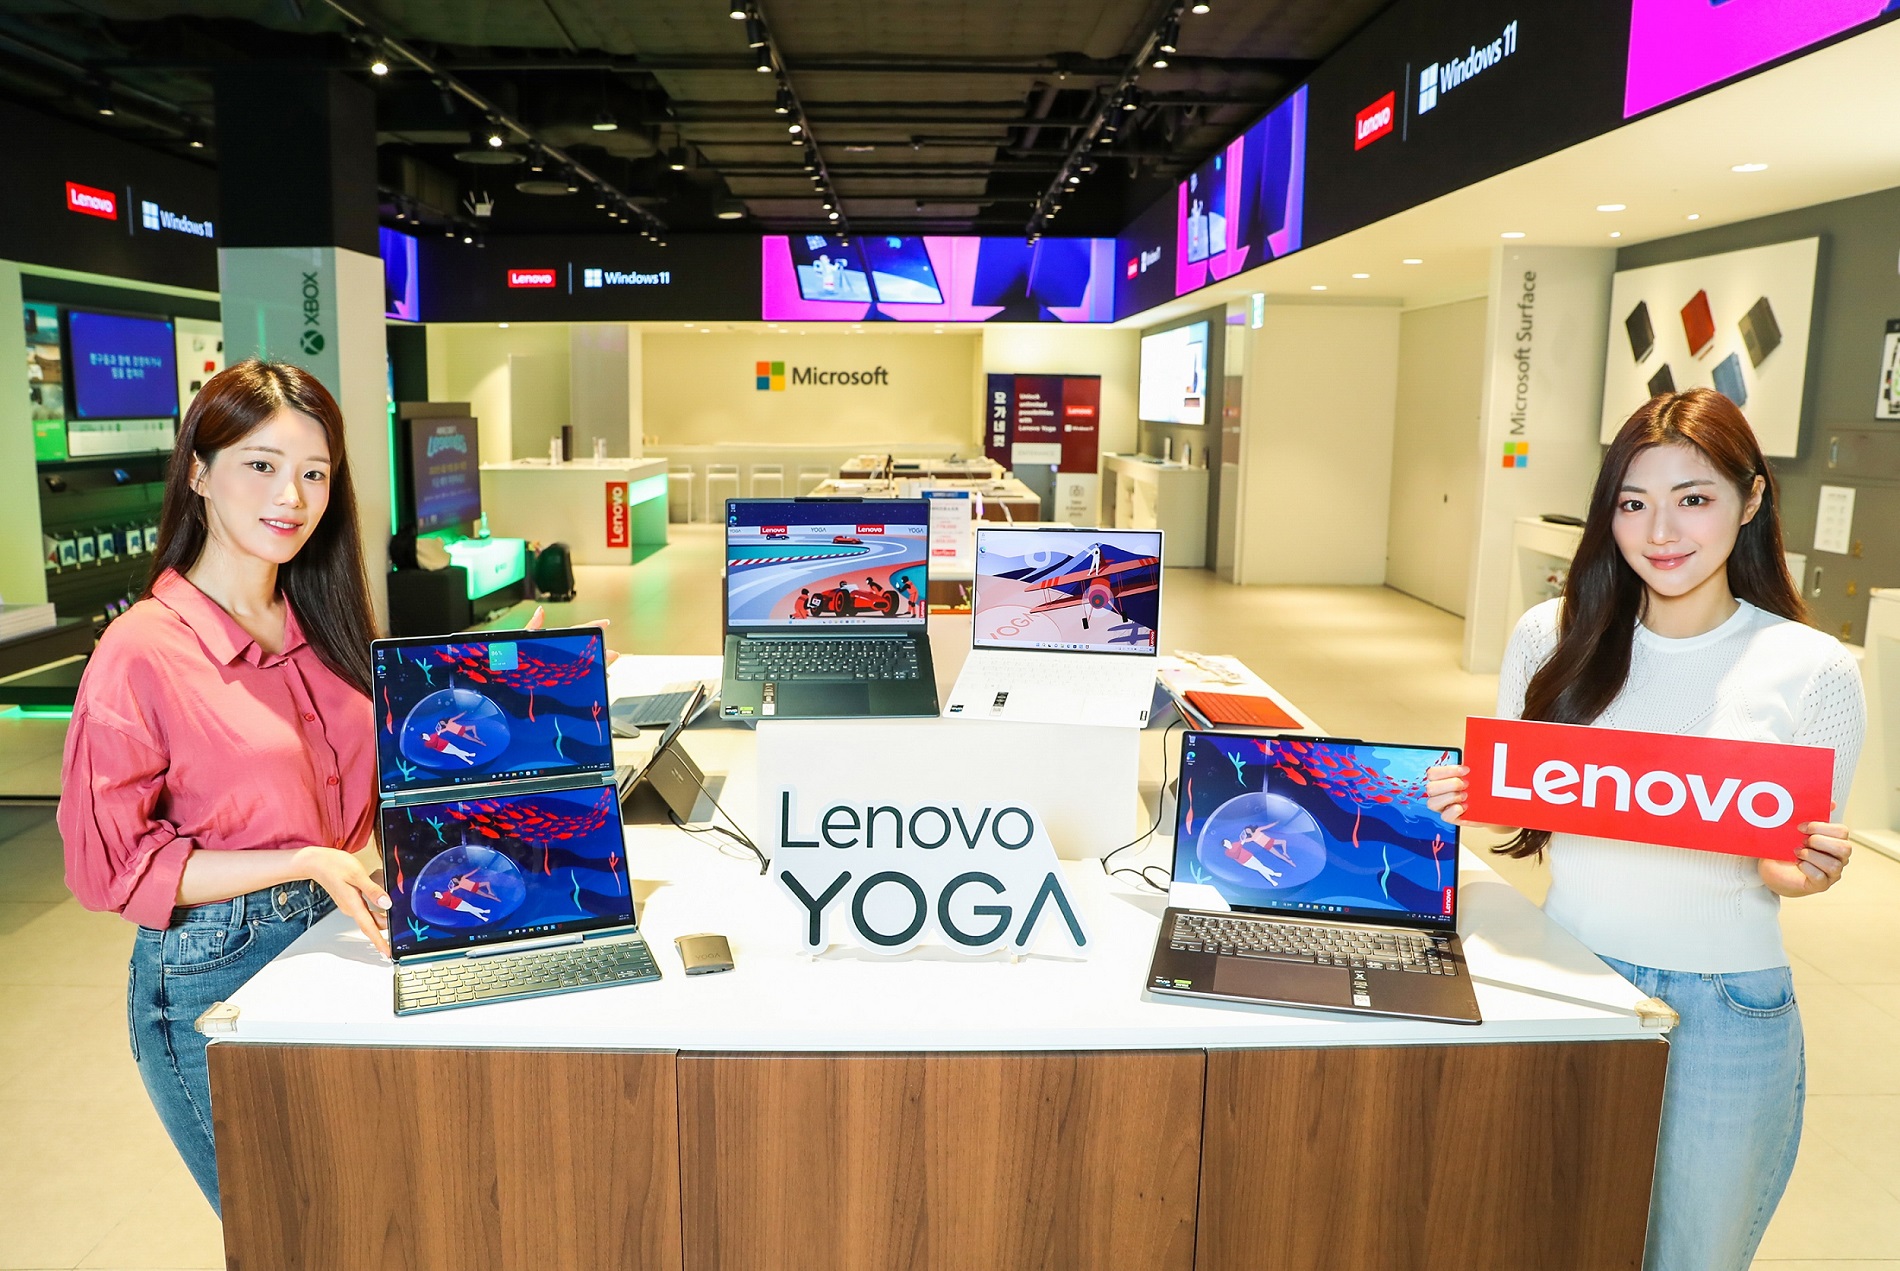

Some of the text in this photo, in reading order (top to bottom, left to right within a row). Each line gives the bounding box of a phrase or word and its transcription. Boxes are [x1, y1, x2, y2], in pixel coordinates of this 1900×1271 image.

[1440, 19, 1518, 94] Windows 11
[1358, 106, 1391, 140] Lenovo
[71, 188, 114, 213] Lenovo
[160, 209, 214, 238] Windows 11
[302, 271, 320, 326] XBOX
[511, 273, 552, 284] Lenovo
[604, 271, 671, 285] Windows 11
[1509, 270, 1537, 436] Microsoft Surface
[792, 366, 888, 385] Microsoft
[610, 486, 624, 543] Lenovo
[1491, 743, 1795, 829] Lenovo
[781, 791, 1034, 850] Lenovo
[780, 871, 1087, 947] YOGA
[1444, 888, 1452, 914] Lenovo
